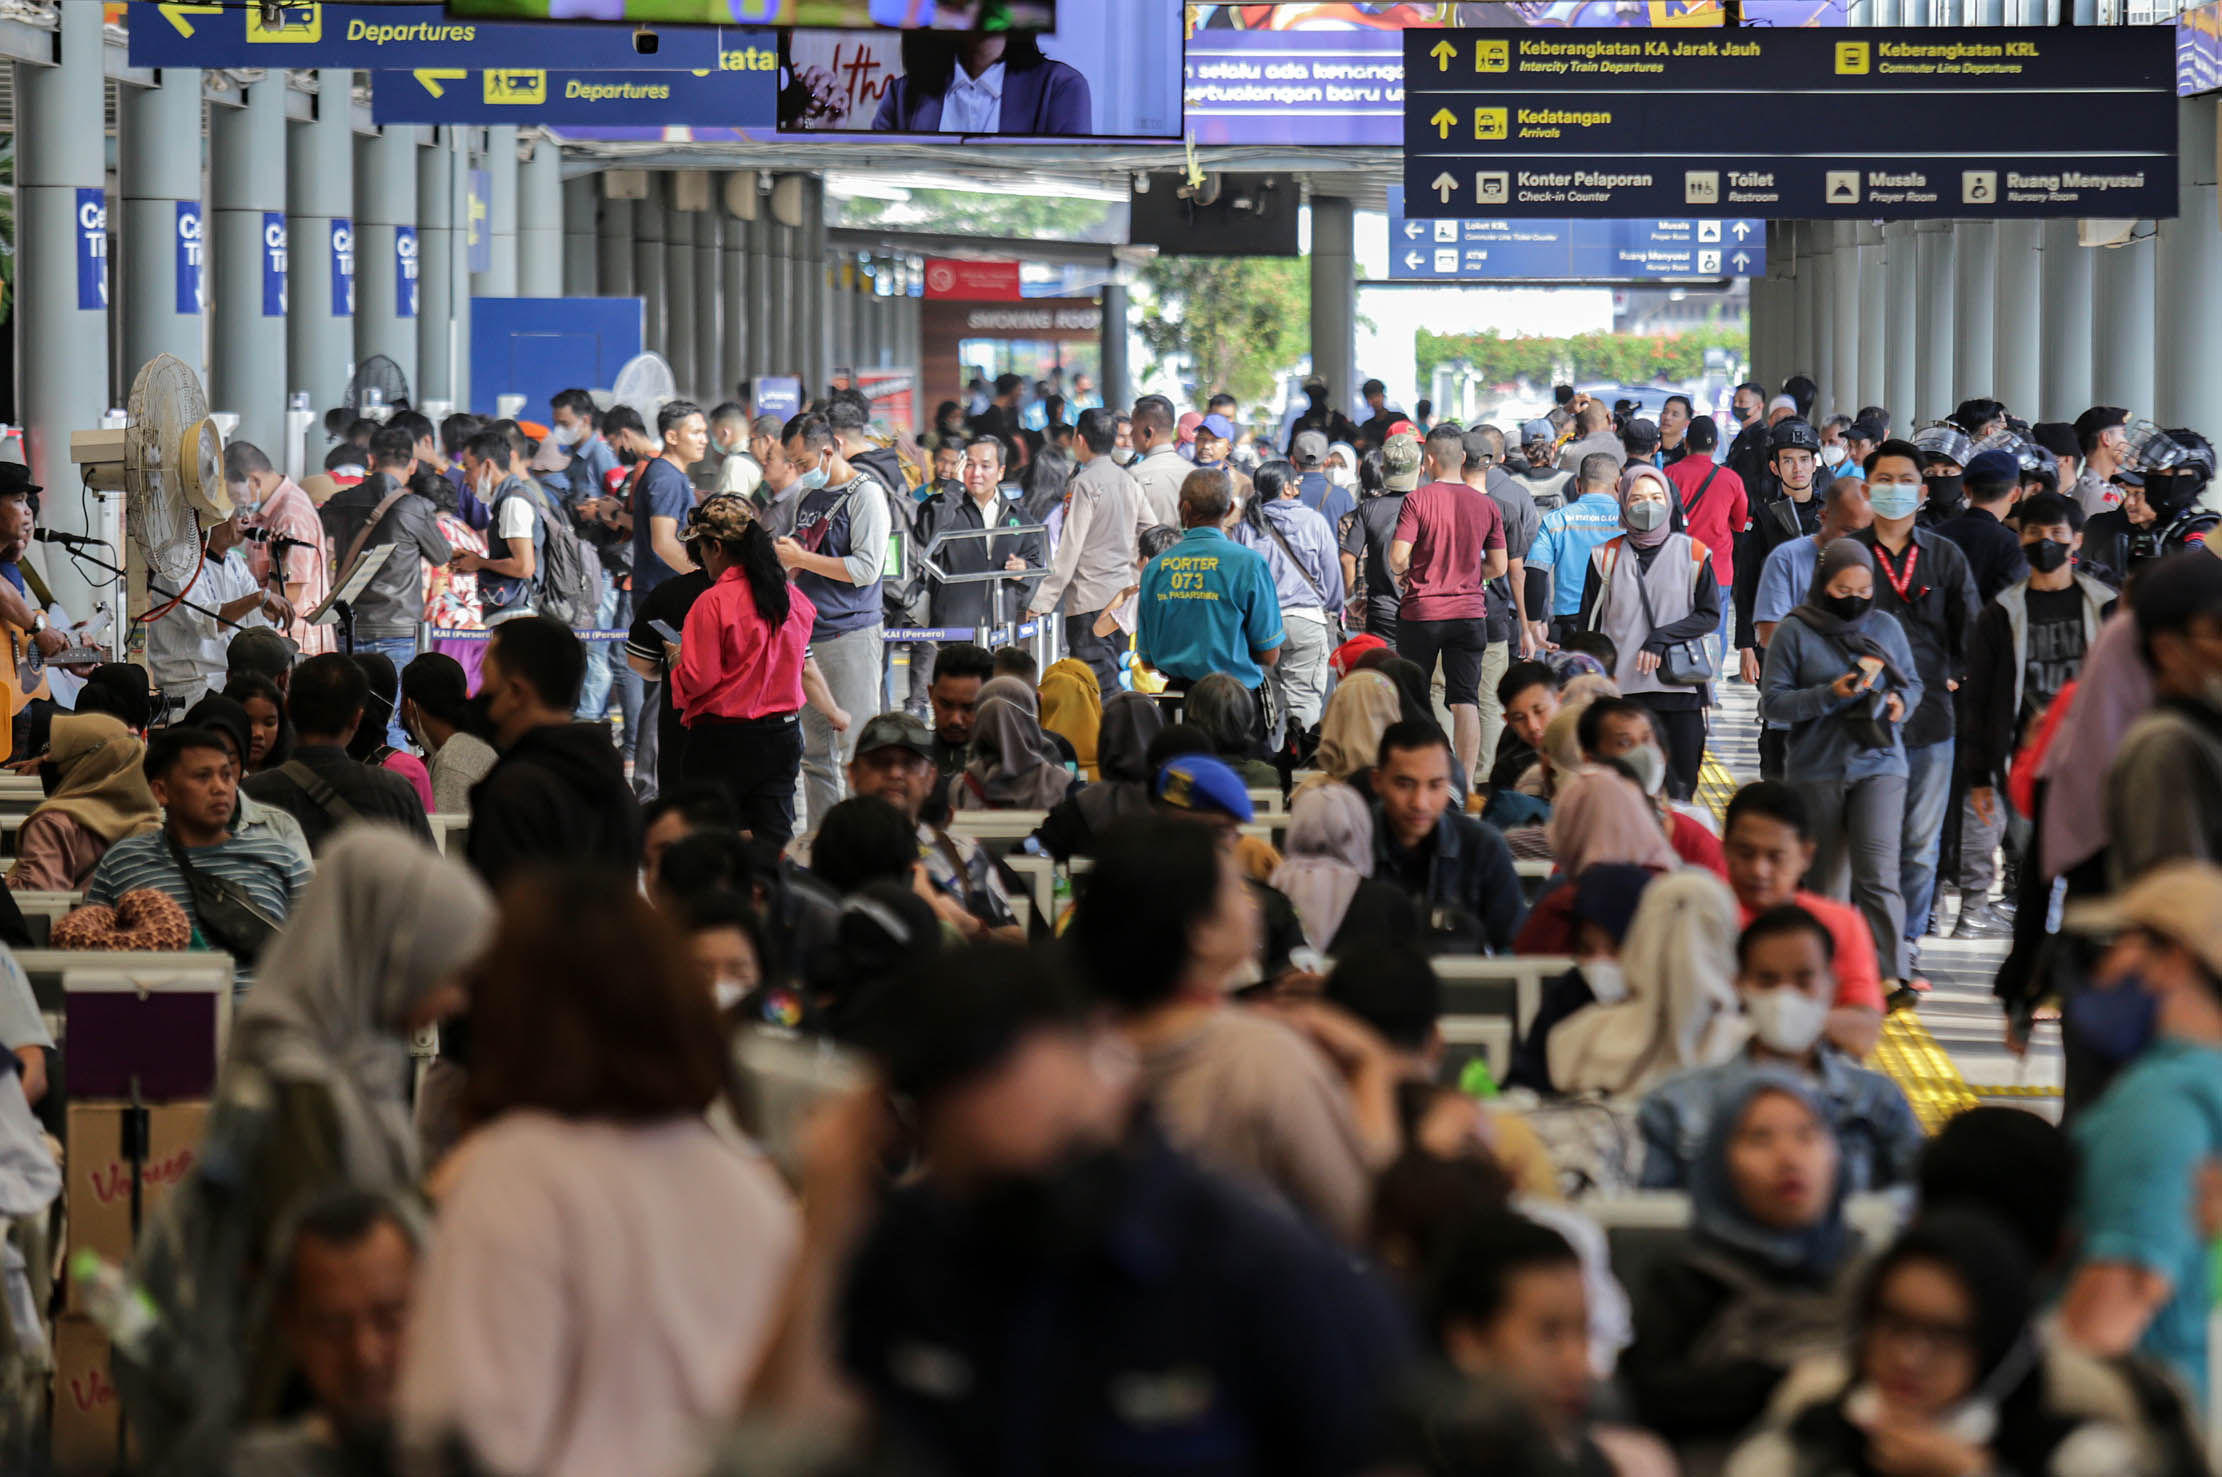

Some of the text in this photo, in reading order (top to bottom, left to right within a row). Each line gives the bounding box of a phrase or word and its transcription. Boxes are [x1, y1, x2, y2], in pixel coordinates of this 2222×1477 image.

[347, 20, 476, 45] Departures
[1519, 41, 1761, 58] Keberangkatan KA Jarak Jauh
[1879, 43, 2040, 60] Keberangkatan KRL
[720, 46, 779, 71] kata
[1198, 62, 1261, 79] selalu
[1265, 63, 1309, 79] ada
[1519, 61, 1664, 74] Intercity Train Departures
[1879, 63, 2023, 75] Commuter Line Departures
[565, 80, 670, 102] Departures
[1326, 85, 1380, 101] baru
[1518, 109, 1612, 127] Kedatangan
[1519, 128, 1561, 139] Arrivals
[1518, 172, 1653, 189] Konter Pelaporan
[1728, 172, 1774, 187] Toilet
[1869, 172, 1926, 187] Musala
[2007, 172, 2144, 191] Ruang Menyusui
[1518, 191, 1610, 202] Check-in Counter
[1728, 192, 1779, 202] Restroom
[1869, 192, 1937, 203] Prayer Room
[2049, 192, 2078, 202] Room
[1054, 310, 1102, 329] ROO
[1160, 557, 1219, 571] PORTER
[1171, 572, 1204, 589] 073
[433, 630, 451, 639] KAI
[883, 630, 946, 640] KAI (Persero)
